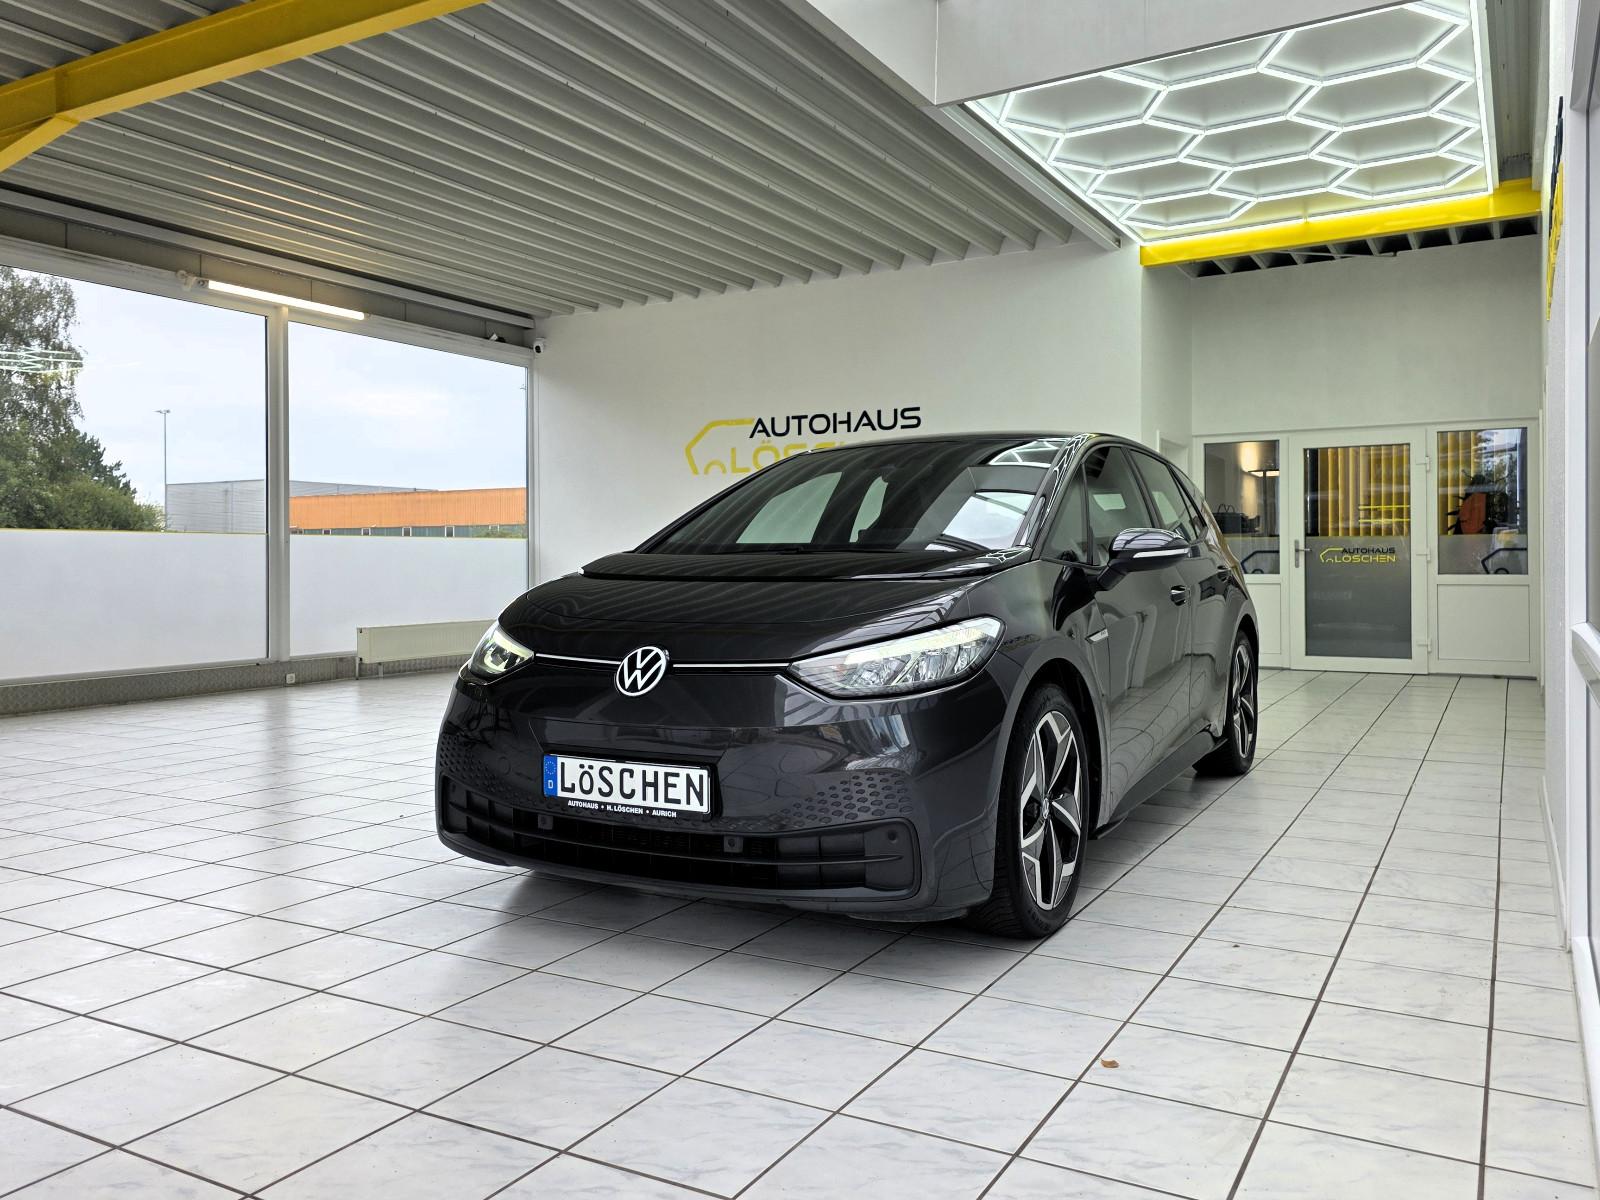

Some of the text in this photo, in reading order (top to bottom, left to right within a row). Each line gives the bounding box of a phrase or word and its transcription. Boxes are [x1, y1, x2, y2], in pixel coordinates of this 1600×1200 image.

[749, 406, 921, 439] AUTOHAUS
[1334, 553, 1396, 563] LÖSCHEN
[547, 779, 554, 789] D
[560, 761, 704, 807] LÖSCHEN
[567, 799, 599, 809] AUTOHAUS
[651, 809, 677, 818] AURICH
